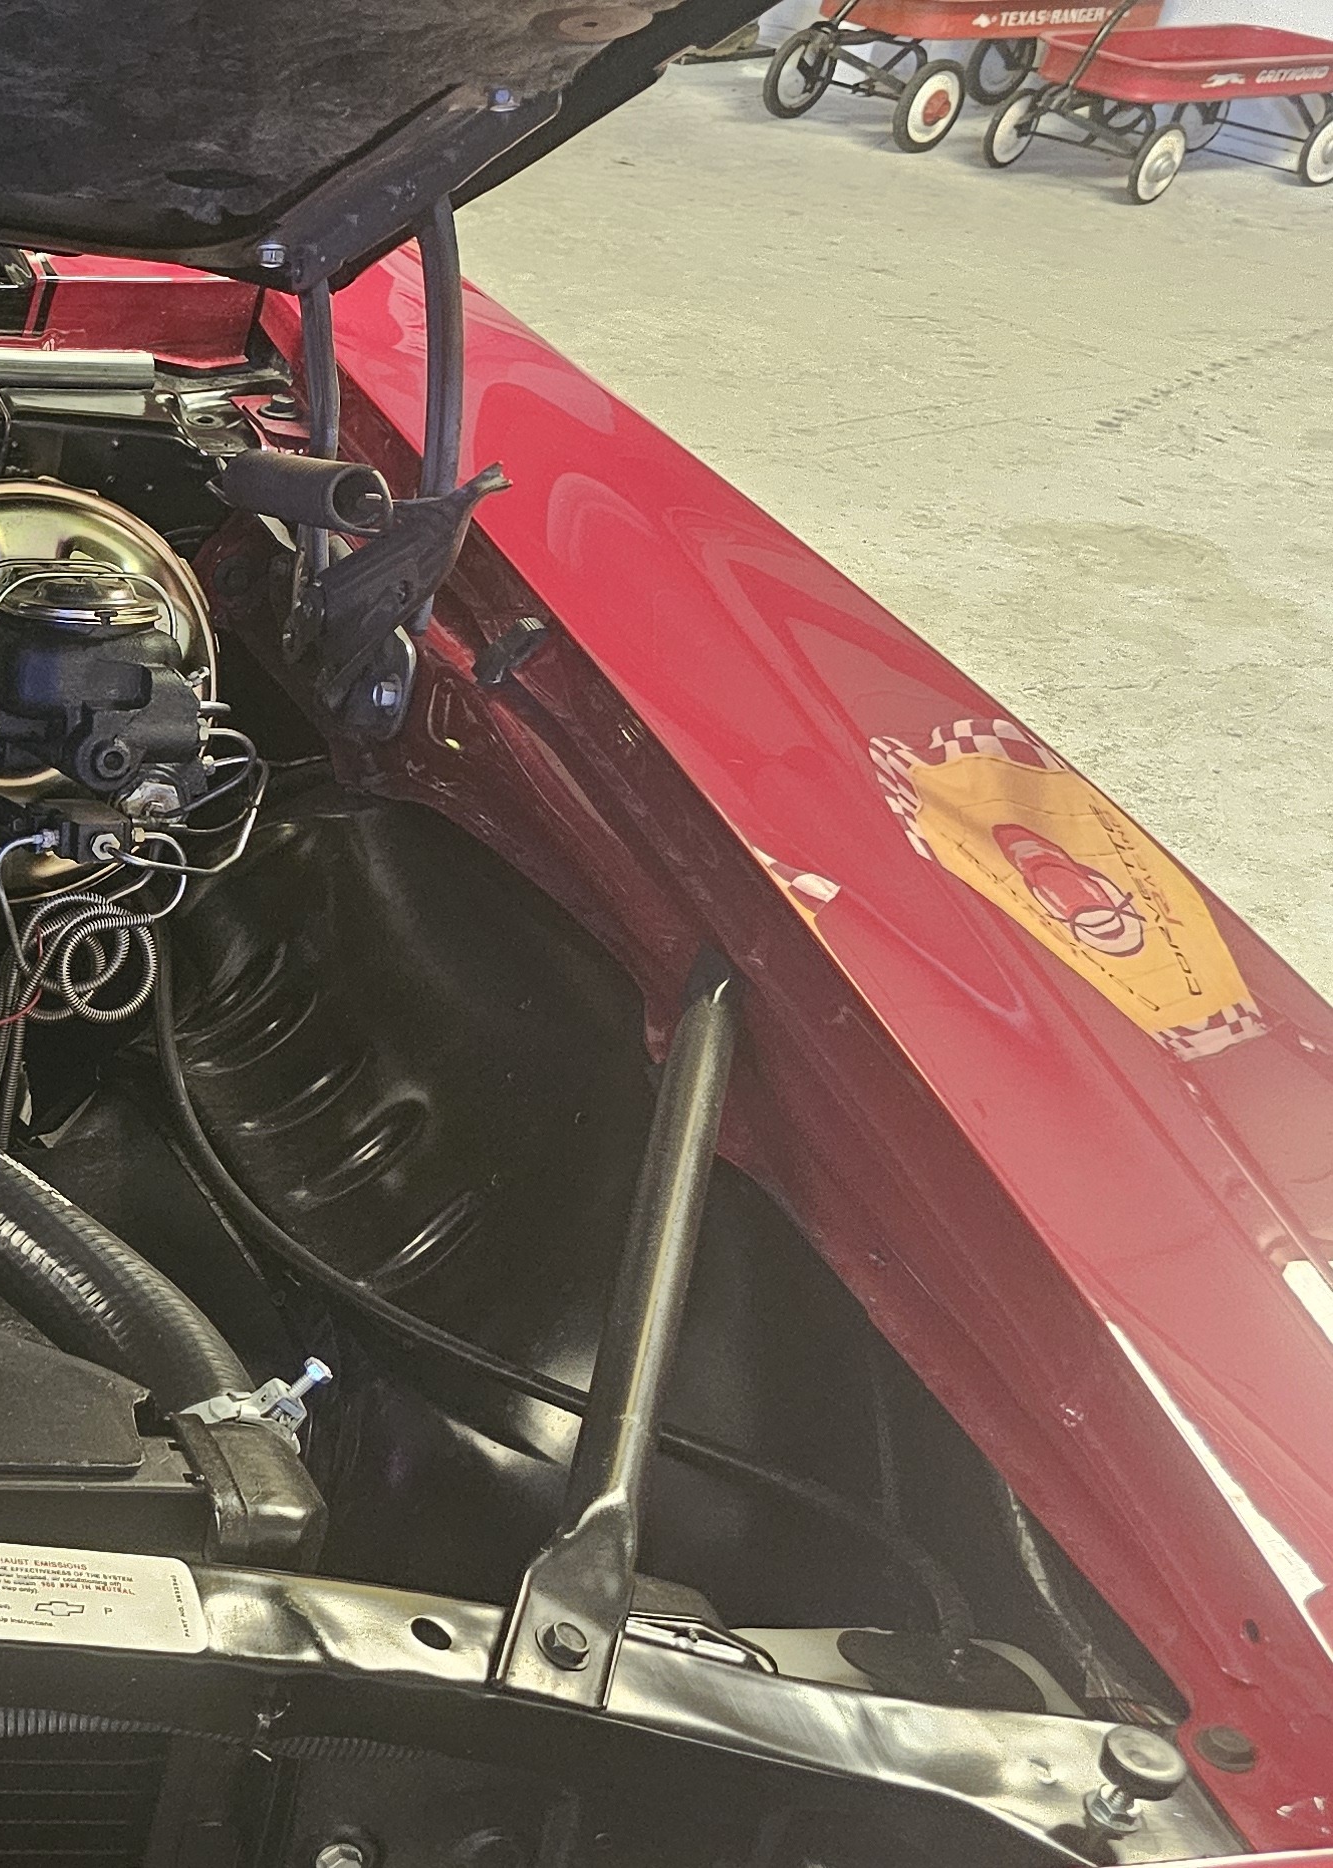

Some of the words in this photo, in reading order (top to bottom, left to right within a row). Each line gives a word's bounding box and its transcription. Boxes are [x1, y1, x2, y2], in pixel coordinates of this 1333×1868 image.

[1000, 10, 1045, 26] TEXAS
[1050, 7, 1104, 24] RANGER
[1255, 66, 1330, 84] GREYHOUND
[34, 1559, 87, 1570] EMISSIONS
[104, 1606, 113, 1614] P
